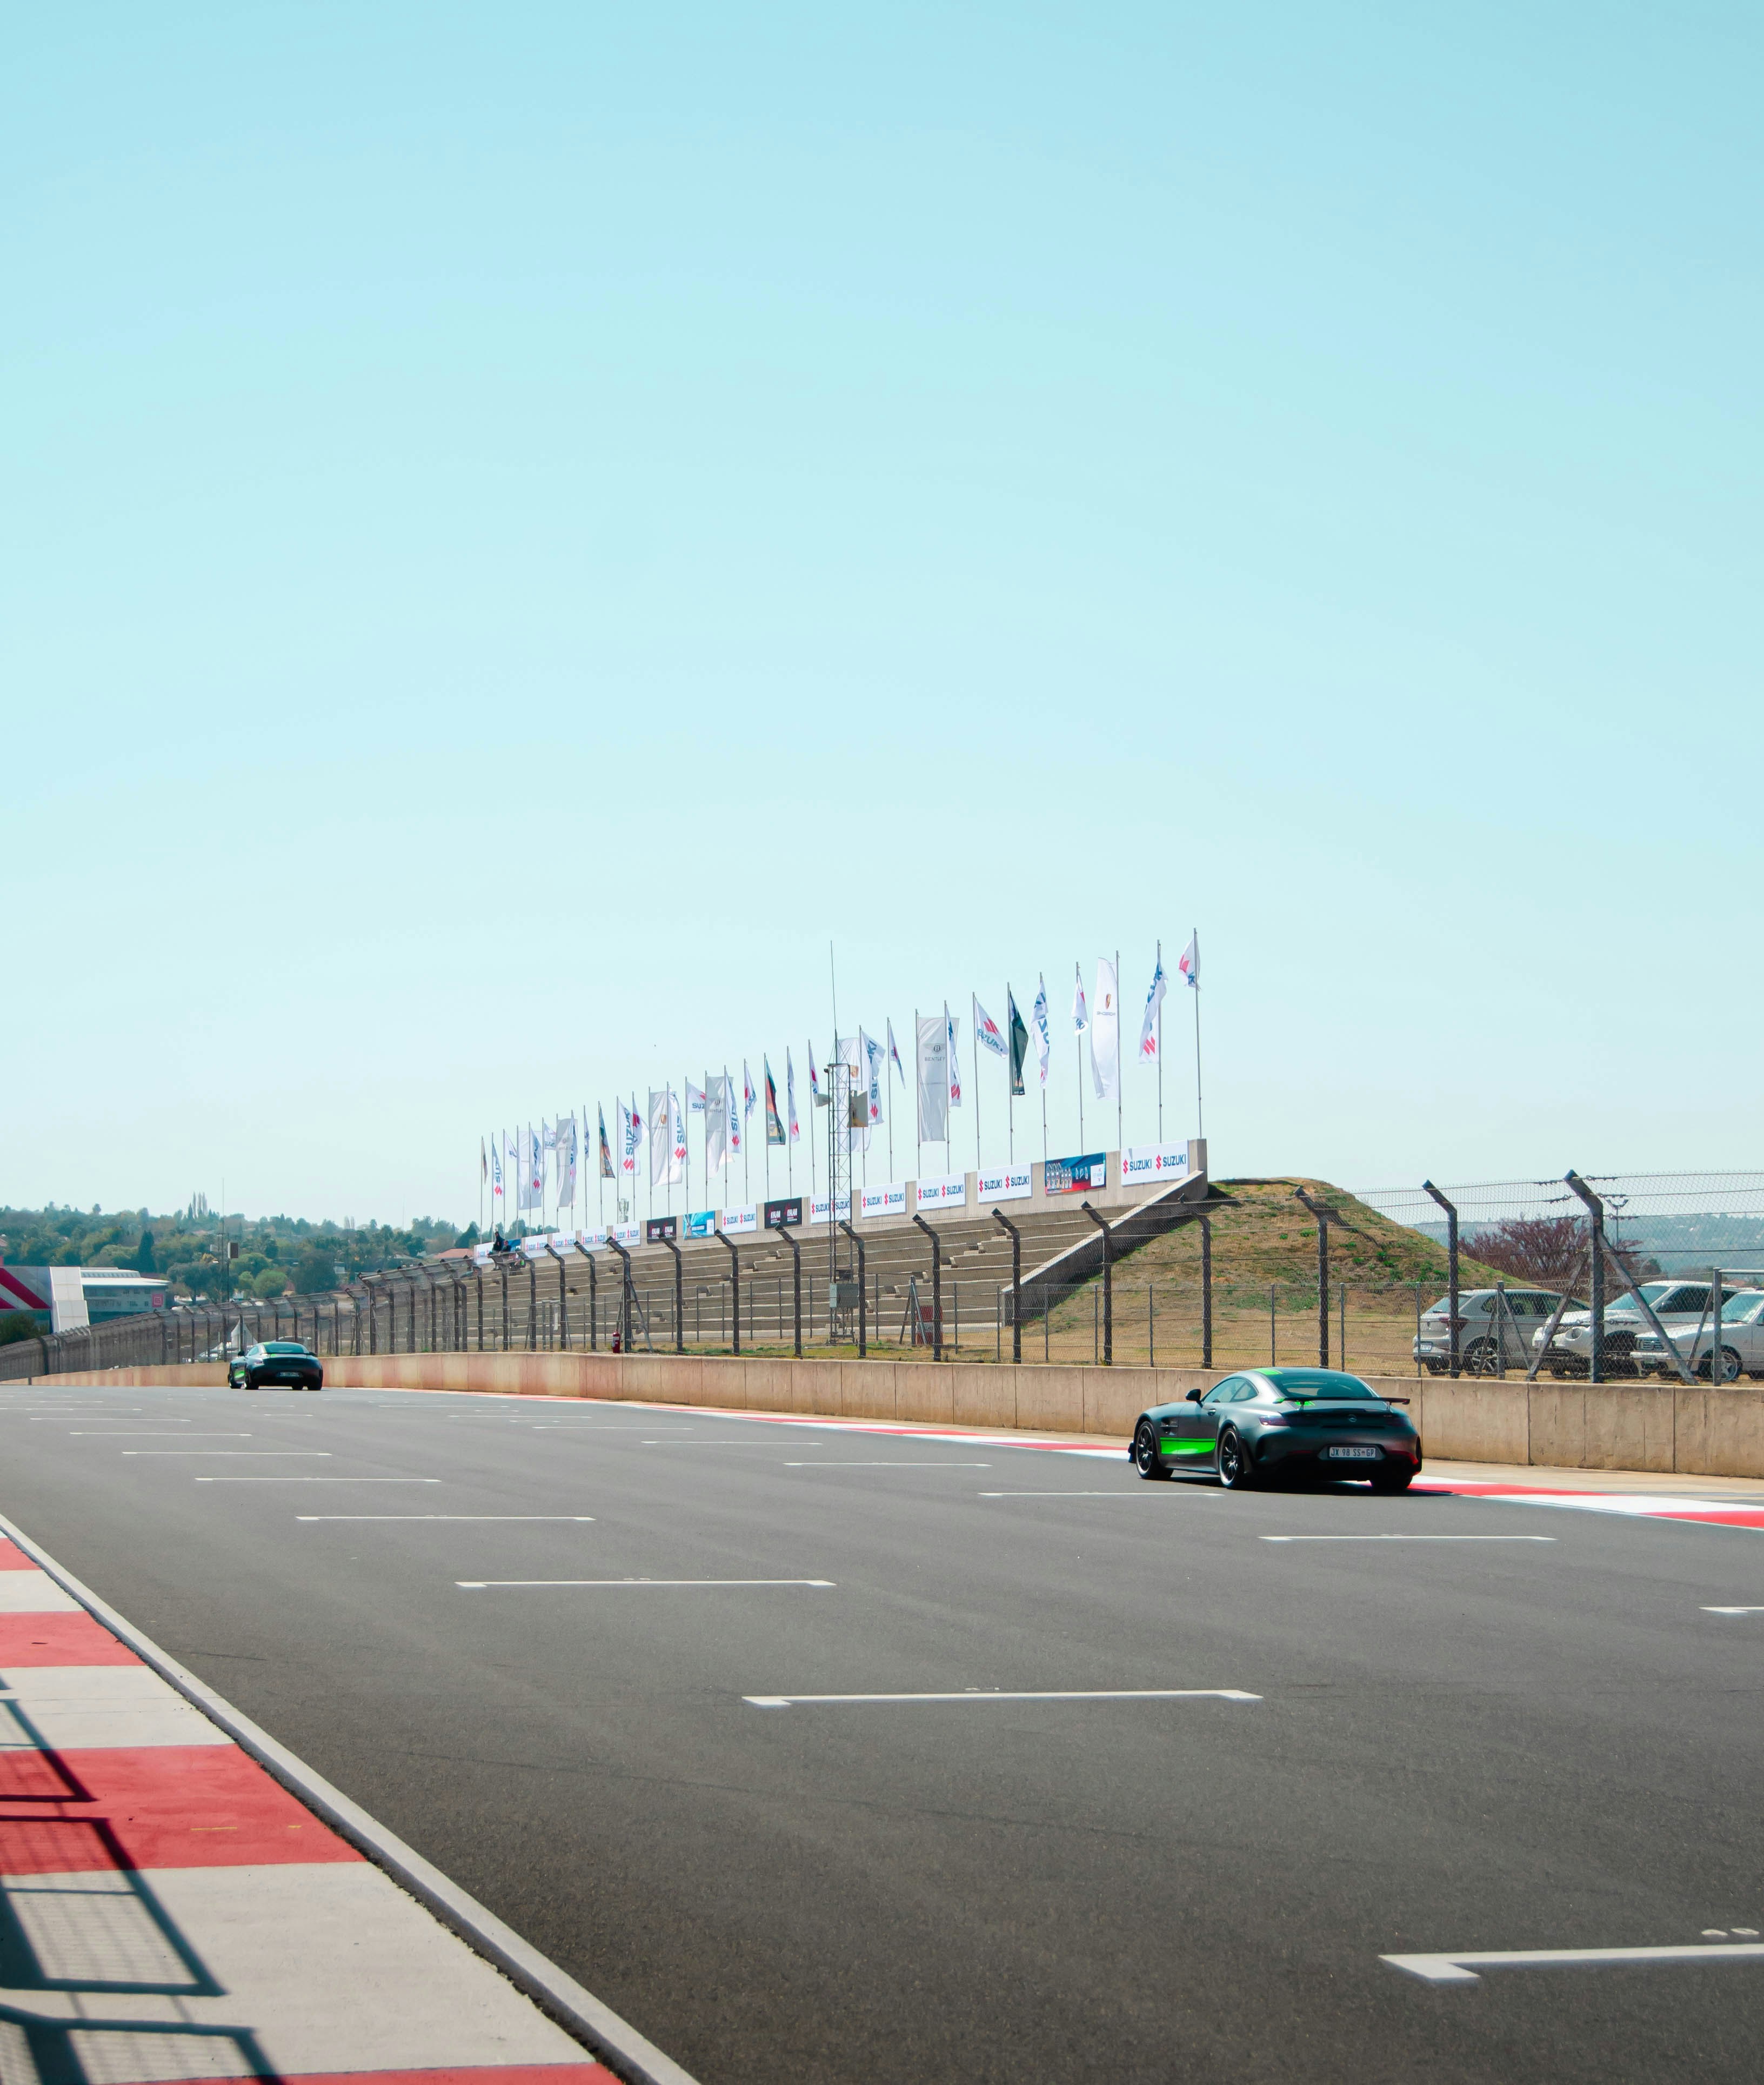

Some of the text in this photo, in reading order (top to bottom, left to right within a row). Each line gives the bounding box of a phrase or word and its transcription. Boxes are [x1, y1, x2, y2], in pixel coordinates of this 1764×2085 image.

[1130, 1154, 1186, 1171] SUZUKI SUZUKI
[984, 1175, 1030, 1190] SUZUKI SUZUKI
[923, 1184, 964, 1198] SUZUKI SUZUKI
[867, 1193, 904, 1206] SUZUKI SUZUKI
[726, 1213, 756, 1224] SUZUKI SUZUKI
[1353, 1449, 1361, 1457] SS
